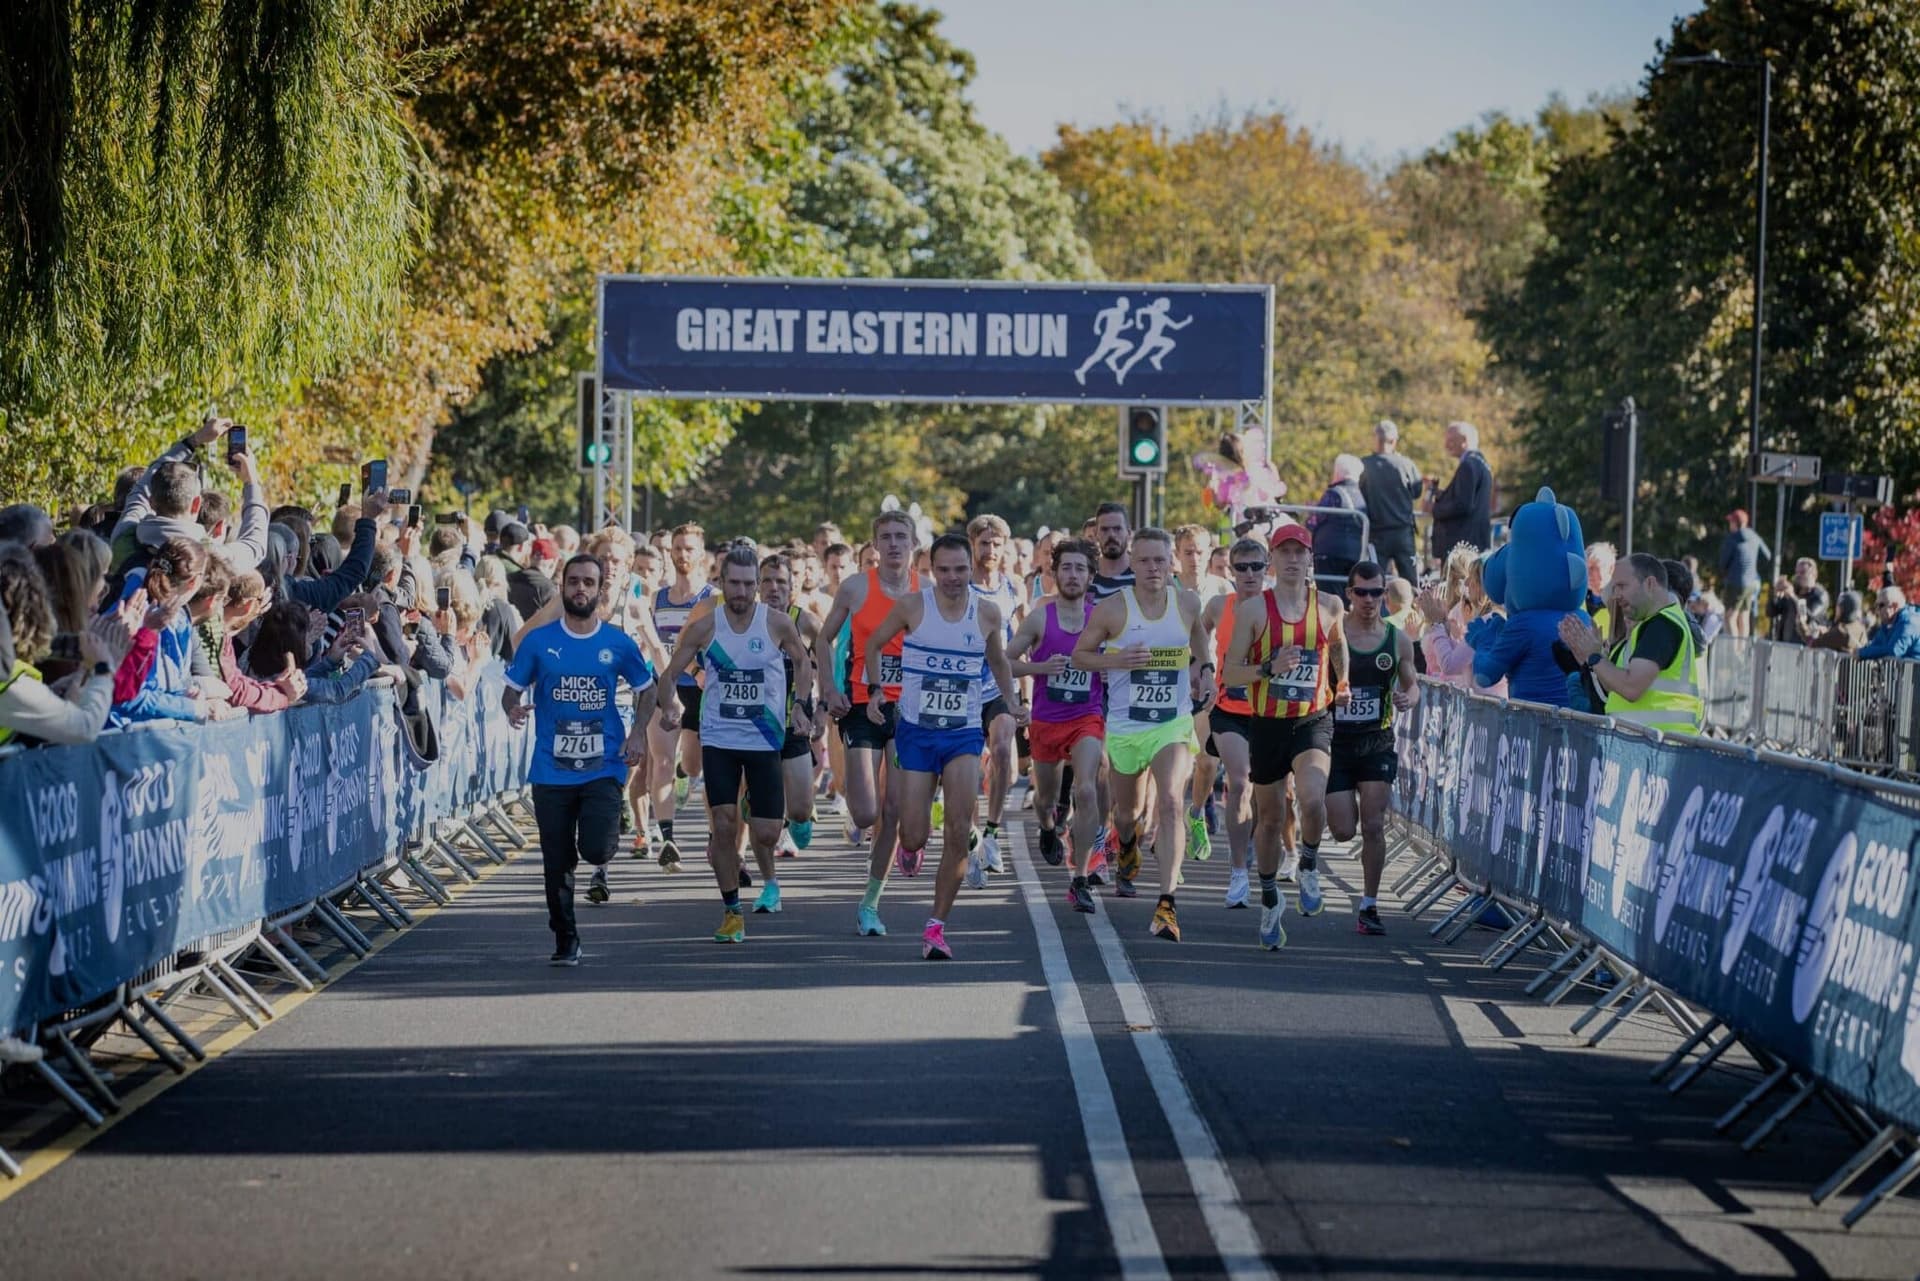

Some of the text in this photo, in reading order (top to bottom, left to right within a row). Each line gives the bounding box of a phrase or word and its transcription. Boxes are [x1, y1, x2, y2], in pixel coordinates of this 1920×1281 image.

[677, 307, 1068, 358] GREAT EASTERN RUN
[926, 656, 967, 672] C & C
[560, 676, 598, 689] MICK
[1055, 669, 1087, 686] 1920
[552, 688, 607, 702] GEORGE
[724, 684, 758, 700] 2480
[1136, 686, 1172, 702] 2265
[579, 702, 607, 711] GROUP
[926, 692, 961, 711] 2165
[1343, 700, 1375, 716] 1855
[560, 736, 595, 753] 2761
[1853, 839, 1909, 920] GOOD
[1829, 916, 1913, 1013] RUNNING
